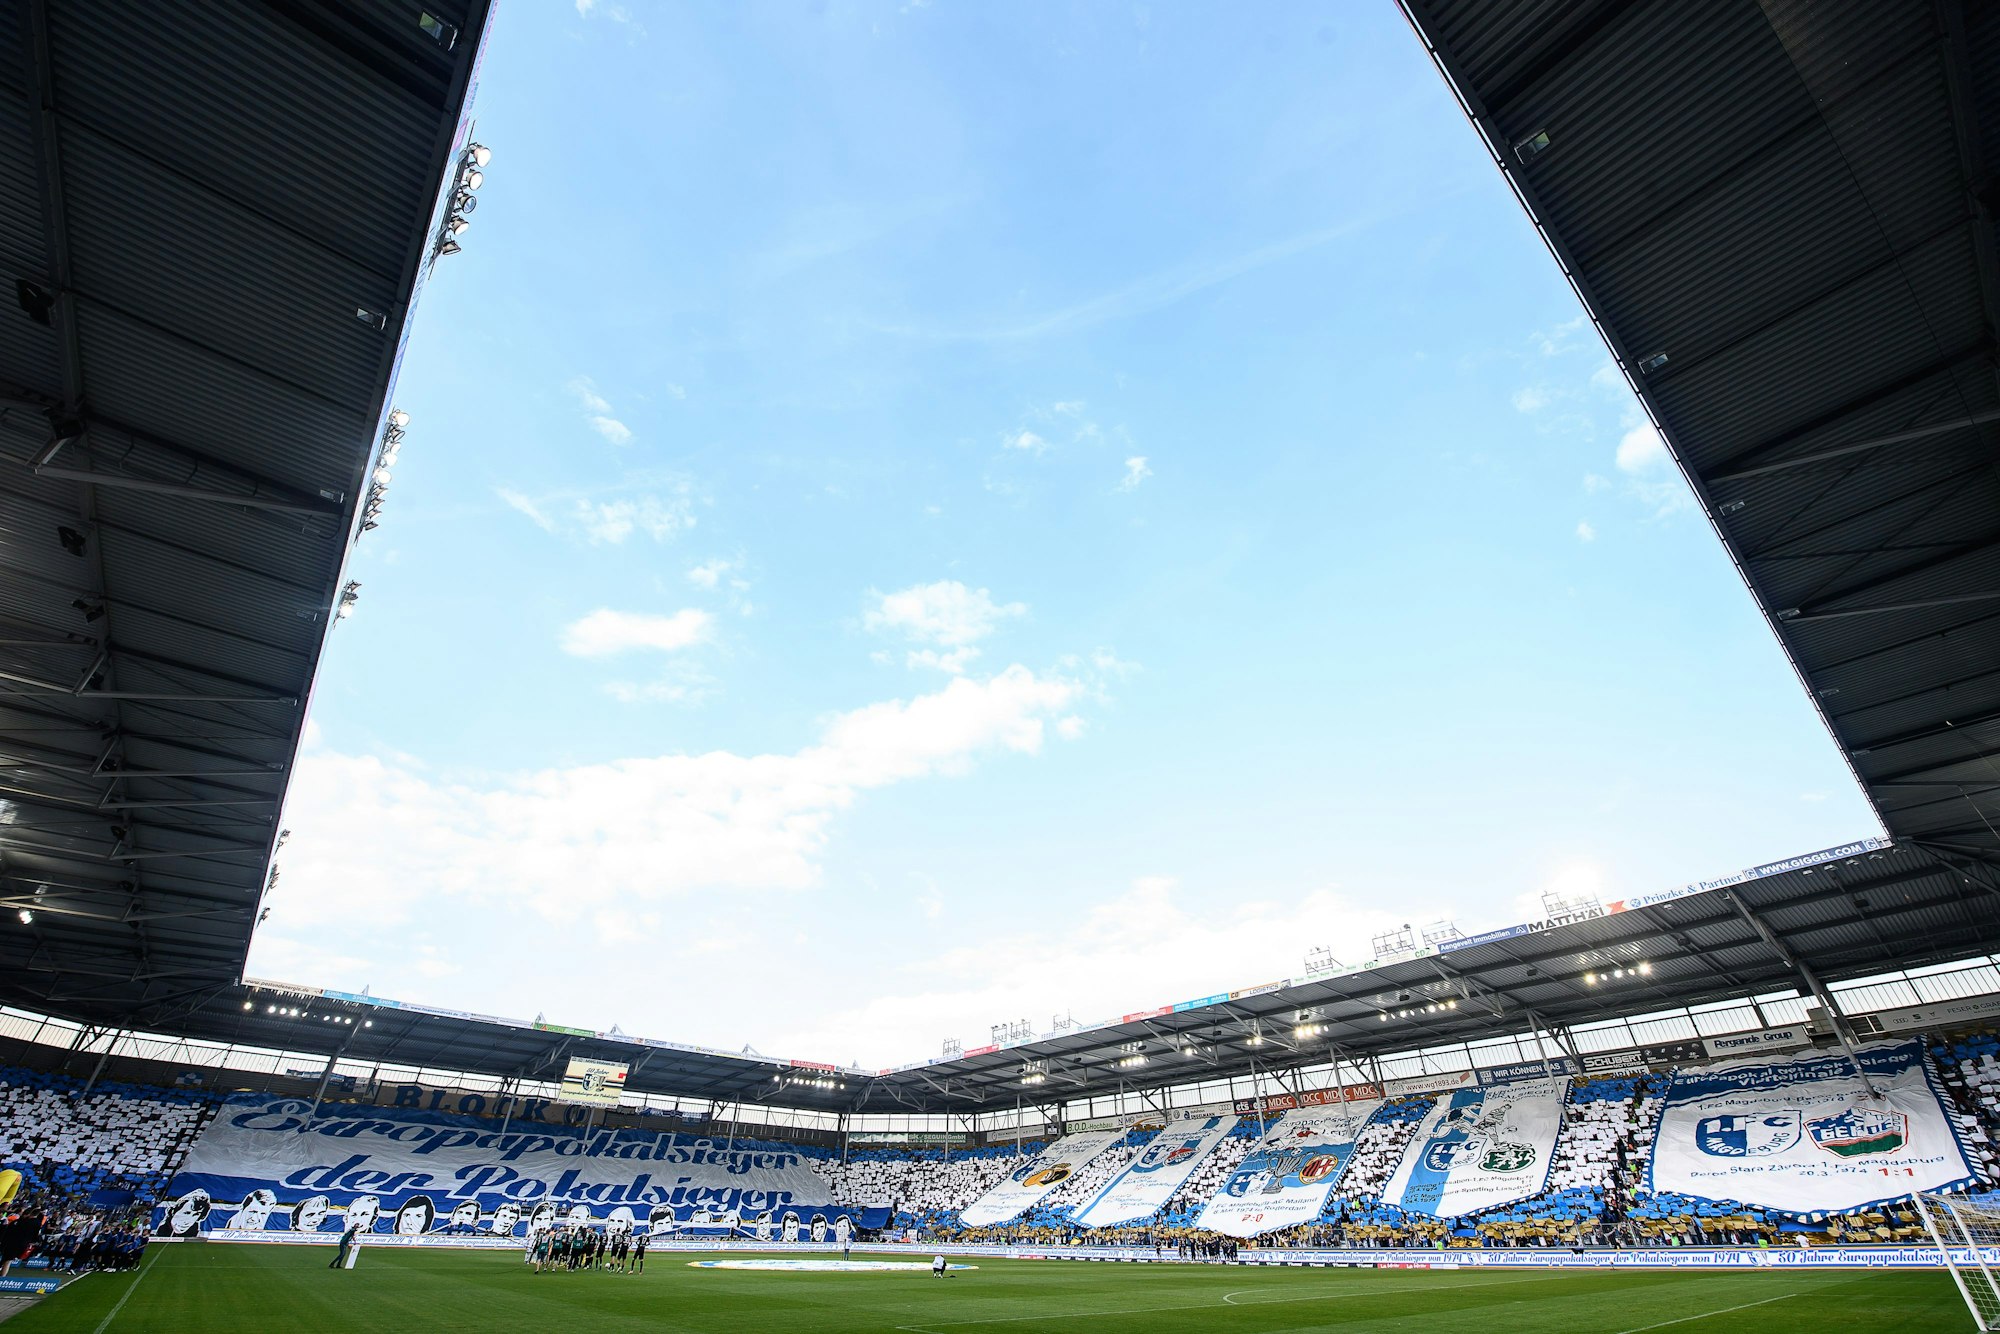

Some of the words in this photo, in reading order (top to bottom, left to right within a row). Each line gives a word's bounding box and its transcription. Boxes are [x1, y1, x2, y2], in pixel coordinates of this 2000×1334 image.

[1759, 844, 1863, 875] WWW.GIGGEL.COM
[1643, 889, 1684, 905] Prinzke
[1687, 885, 1697, 894] &
[1699, 873, 1743, 891] Partner
[1528, 908, 1605, 933] MATTHÄI
[1441, 936, 1473, 951] Aengevelt
[1473, 929, 1511, 944] Immobilien
[1249, 983, 1279, 995] LOGISTICS
[1714, 1034, 1760, 1049] Pergande
[1764, 1031, 1792, 1041] Group
[1583, 1054, 1642, 1067] SCHUBERT
[1493, 1069, 1508, 1078] WIR
[1509, 1065, 1543, 1076] KÖNNEN
[1353, 1085, 1379, 1098] MDC
[1405, 1079, 1460, 1092] www.wg1893.de
[1486, 1081, 1564, 1097] EUROPAPOKL
[1268, 1096, 1292, 1108] MDCC
[1323, 1088, 1351, 1101] MDC
[396, 1085, 551, 1122] BLOCK
[231, 1099, 802, 1175] Europapokalsieger
[285, 1155, 434, 1192] der
[452, 1163, 794, 1211] Pokalsieger
[1443, 1253, 1462, 1263] 1974
[1488, 1252, 1501, 1263] 50
[1502, 1252, 1527, 1263] Jahre
[1529, 1252, 1608, 1266] Europapokalsieger
[1613, 1252, 1629, 1263] der
[1630, 1252, 1689, 1266] Pokalsieger
[1714, 1251, 1740, 1264] 1974
[1778, 1251, 1796, 1264] 50
[1799, 1250, 1834, 1263] Jahre
[1838, 1249, 1958, 1266] Europapokalsiegr
[25, 1280, 57, 1288] mhkw
